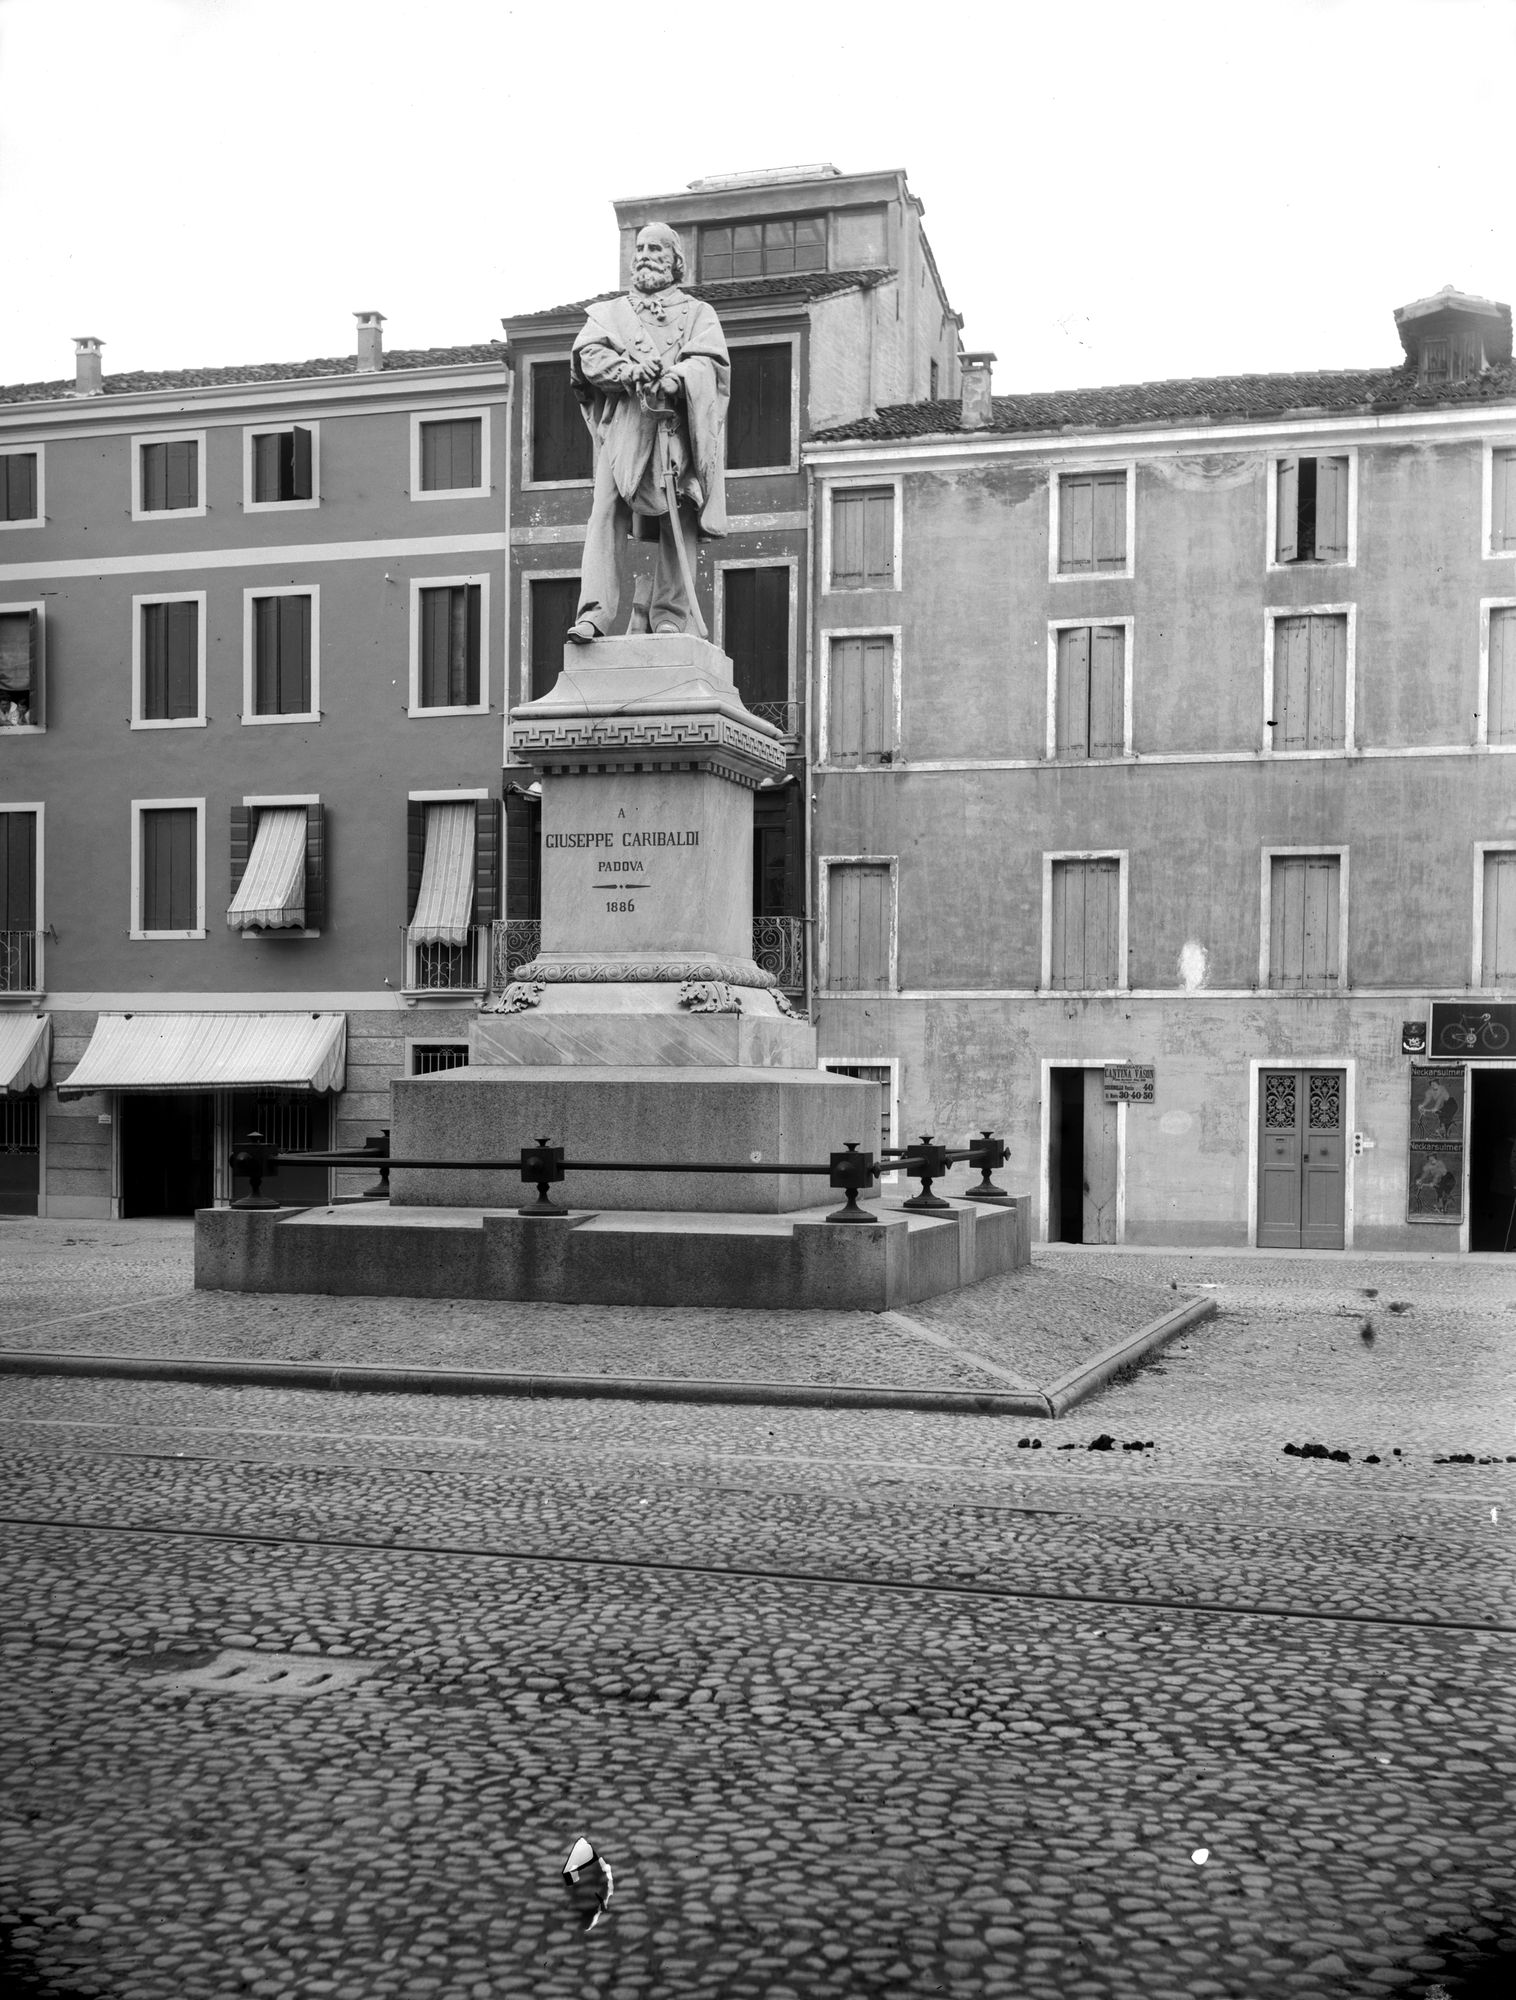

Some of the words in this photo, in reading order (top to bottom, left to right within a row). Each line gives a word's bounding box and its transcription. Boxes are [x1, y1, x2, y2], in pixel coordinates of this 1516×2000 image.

[618, 807, 626, 819] A
[545, 833, 614, 848] GIUSEPPE
[622, 831, 700, 847] GARIBALDI
[598, 861, 644, 872] PADOVA
[606, 899, 635, 912] 1886
